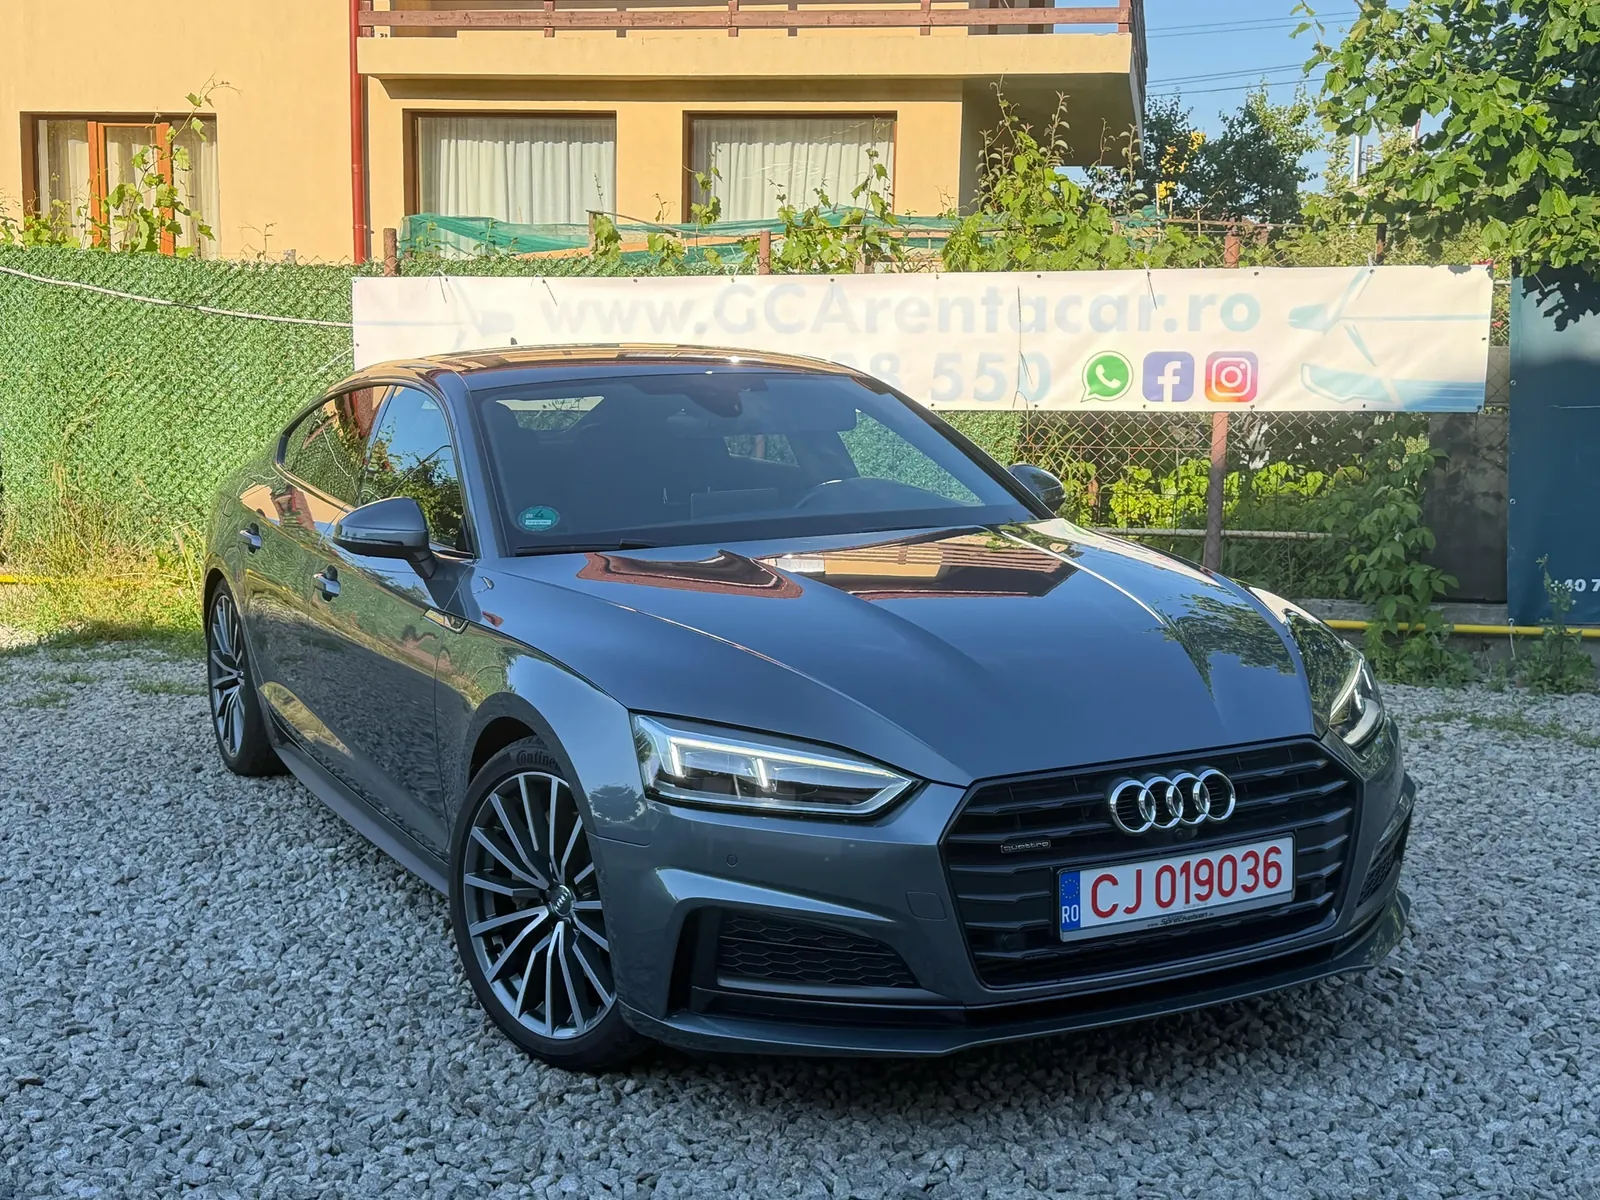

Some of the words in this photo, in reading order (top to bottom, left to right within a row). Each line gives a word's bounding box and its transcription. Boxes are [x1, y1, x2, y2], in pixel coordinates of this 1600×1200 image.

[540, 282, 1262, 337] www.GCArentacar.ro
[930, 351, 1052, 403] 550
[1091, 868, 1143, 919] CJ
[1155, 845, 1283, 909] 019036
[1061, 904, 1080, 924] RO
